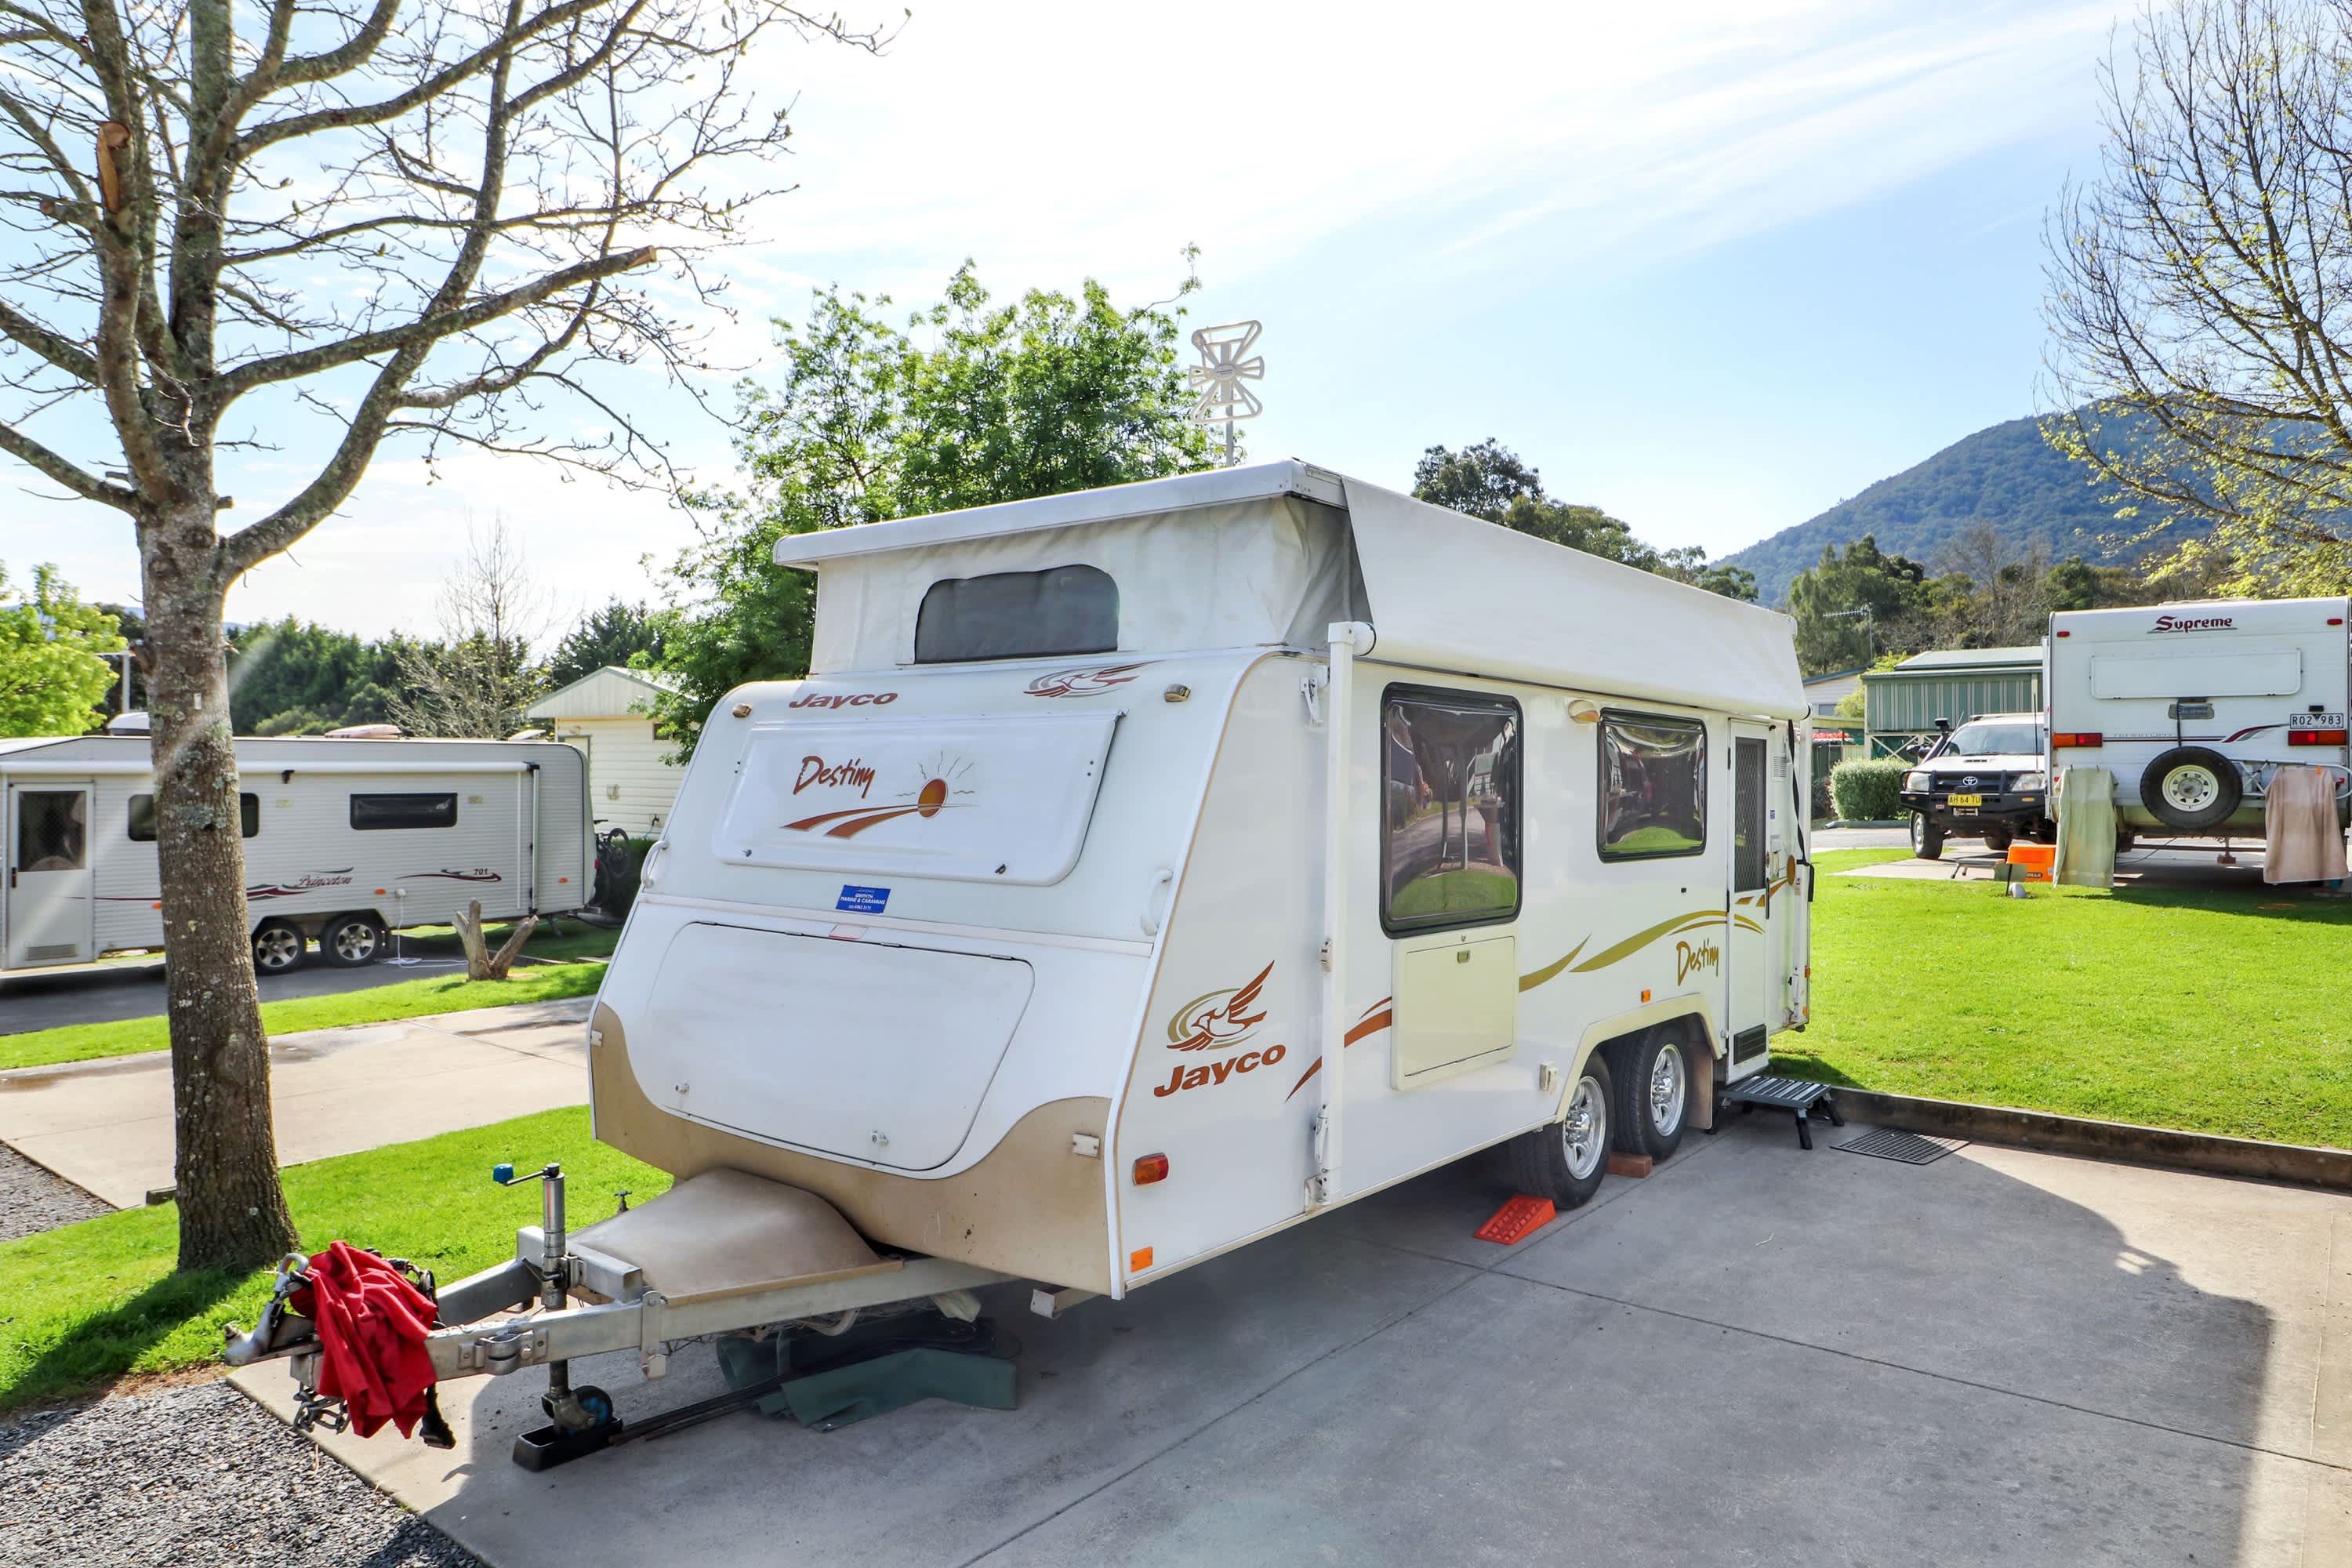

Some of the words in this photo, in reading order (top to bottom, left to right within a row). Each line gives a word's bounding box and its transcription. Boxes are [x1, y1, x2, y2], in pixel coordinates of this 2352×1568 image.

[2152, 615, 2233, 633] Supreme
[789, 692, 898, 709] Jayco
[2321, 715, 2342, 725] 983
[793, 755, 876, 799] Destiny
[299, 874, 353, 887] Princeton
[1676, 938, 1719, 986] Destiny
[1153, 1044, 1286, 1098] Jayco
